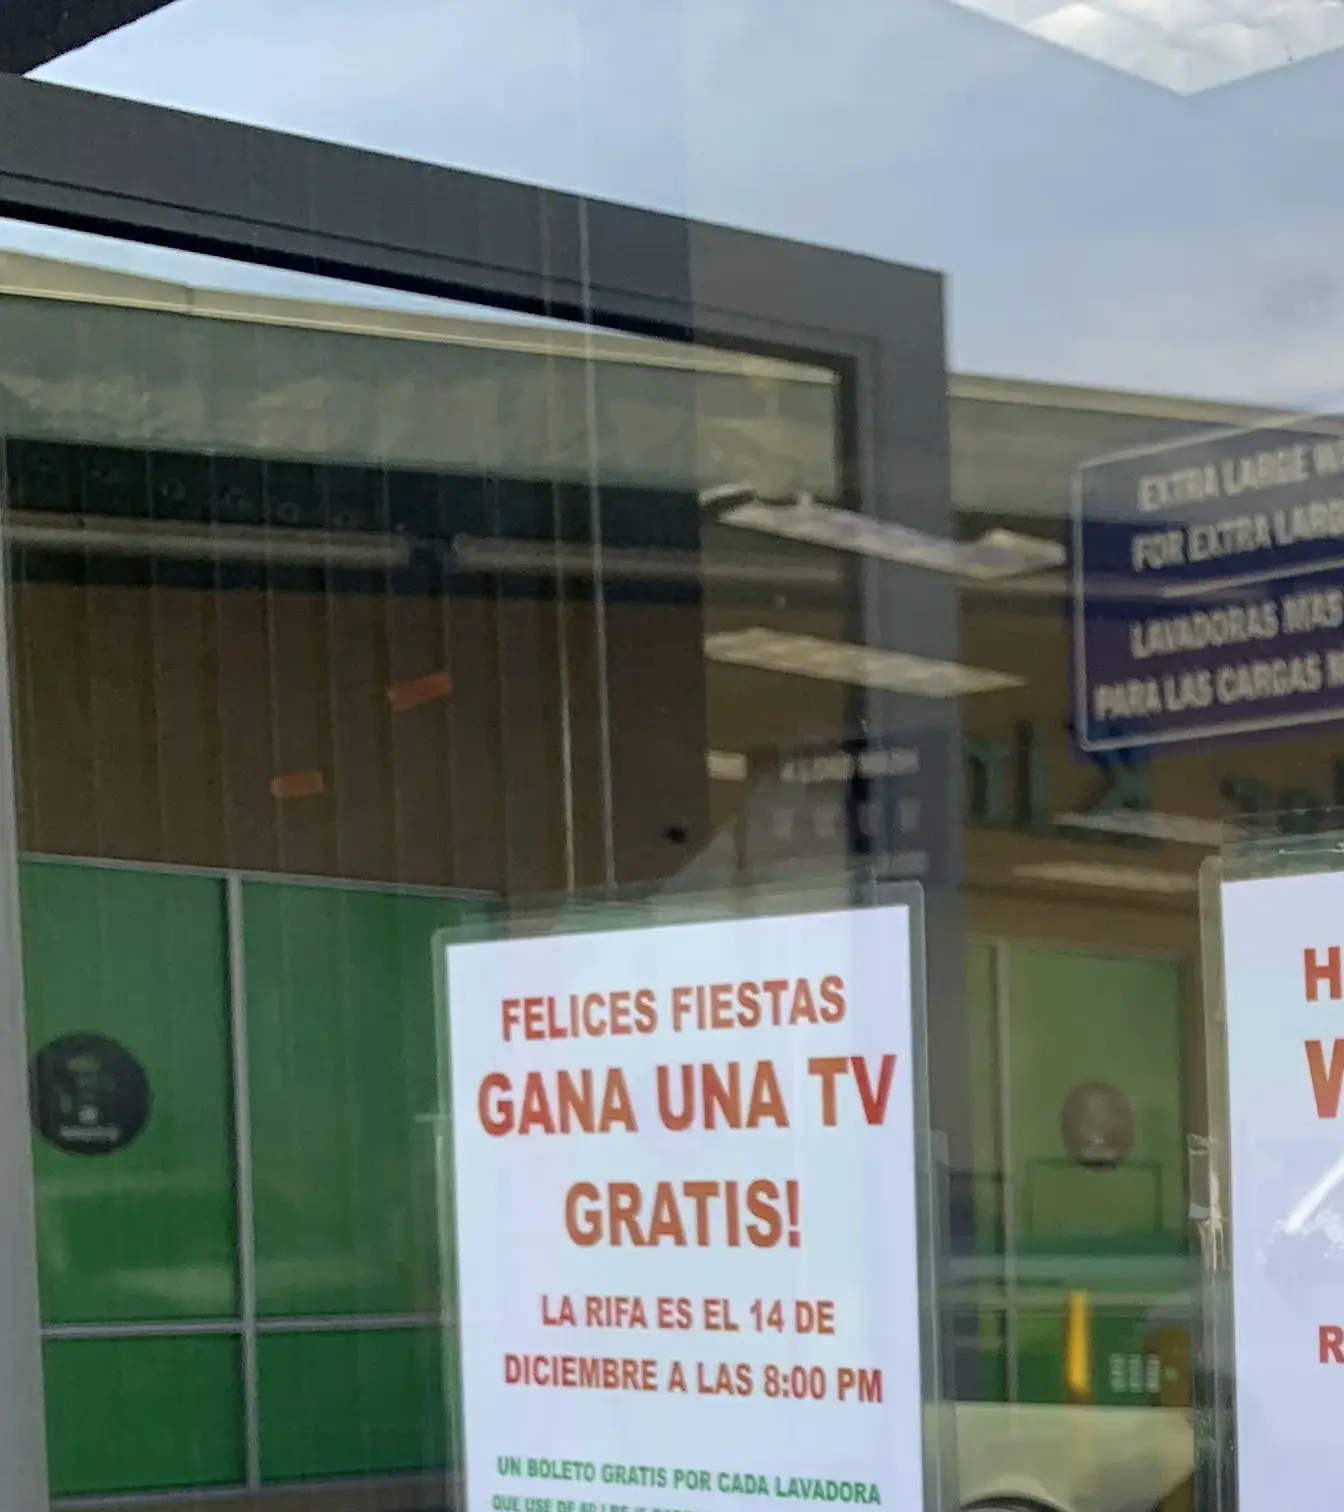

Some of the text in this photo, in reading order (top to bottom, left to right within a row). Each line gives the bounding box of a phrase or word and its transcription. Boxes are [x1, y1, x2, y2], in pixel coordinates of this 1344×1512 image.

[1137, 470, 1218, 511] EXTRA
[1224, 447, 1308, 497] LARGE
[1133, 531, 1185, 571] FOR
[1187, 515, 1271, 562] EXTRA
[1130, 603, 1279, 660] LAVADORAS
[1283, 589, 1344, 633] MAS
[1094, 679, 1162, 720] PARA
[1164, 669, 1214, 710] LAS
[1217, 654, 1322, 702] CARGAS
[500, 974, 847, 1043] FELICES FIESTAS
[476, 1052, 898, 1139] GANA UNA TV
[563, 1177, 802, 1250] GRATIS!
[541, 1293, 836, 1336] LA RIFA ES EL 14 DE
[503, 1352, 884, 1405] DICIEMBRE A LAS 8:00 PM
[496, 1455, 882, 1506] UN BOLETO GRATIS POR CADA LAVADORA
